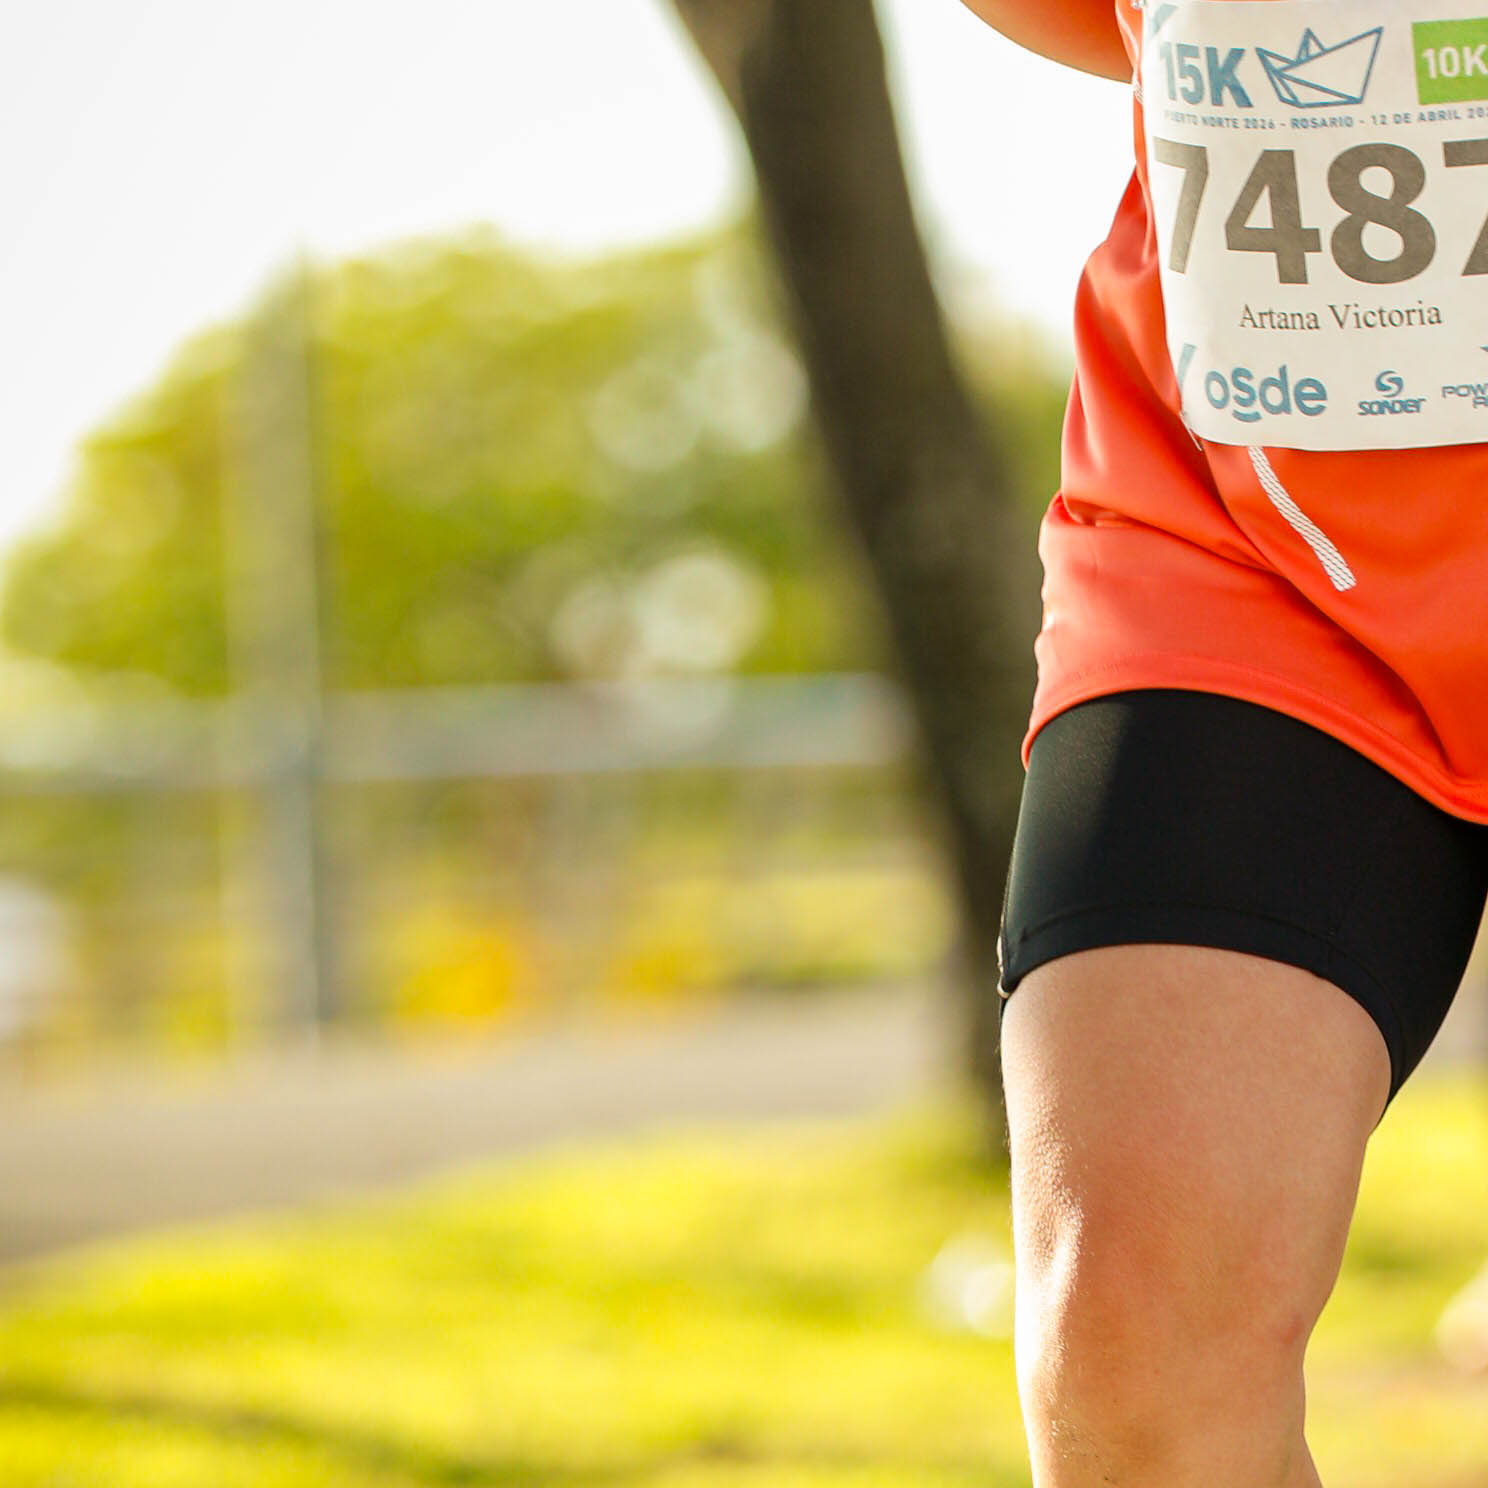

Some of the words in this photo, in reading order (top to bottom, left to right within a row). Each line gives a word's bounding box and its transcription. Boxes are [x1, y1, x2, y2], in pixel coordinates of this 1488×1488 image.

[1160, 41, 1254, 108] 15K
[1201, 115, 1240, 130] NORTE
[1243, 116, 1276, 130] 2026
[1290, 114, 1354, 130] ROSARIO
[1370, 113, 1388, 126] 12
[1393, 111, 1413, 125] DE
[1417, 108, 1462, 123] ABRIL
[1239, 303, 1321, 331] Artana
[1327, 299, 1443, 330] Victoria
[1204, 363, 1328, 422] osde
